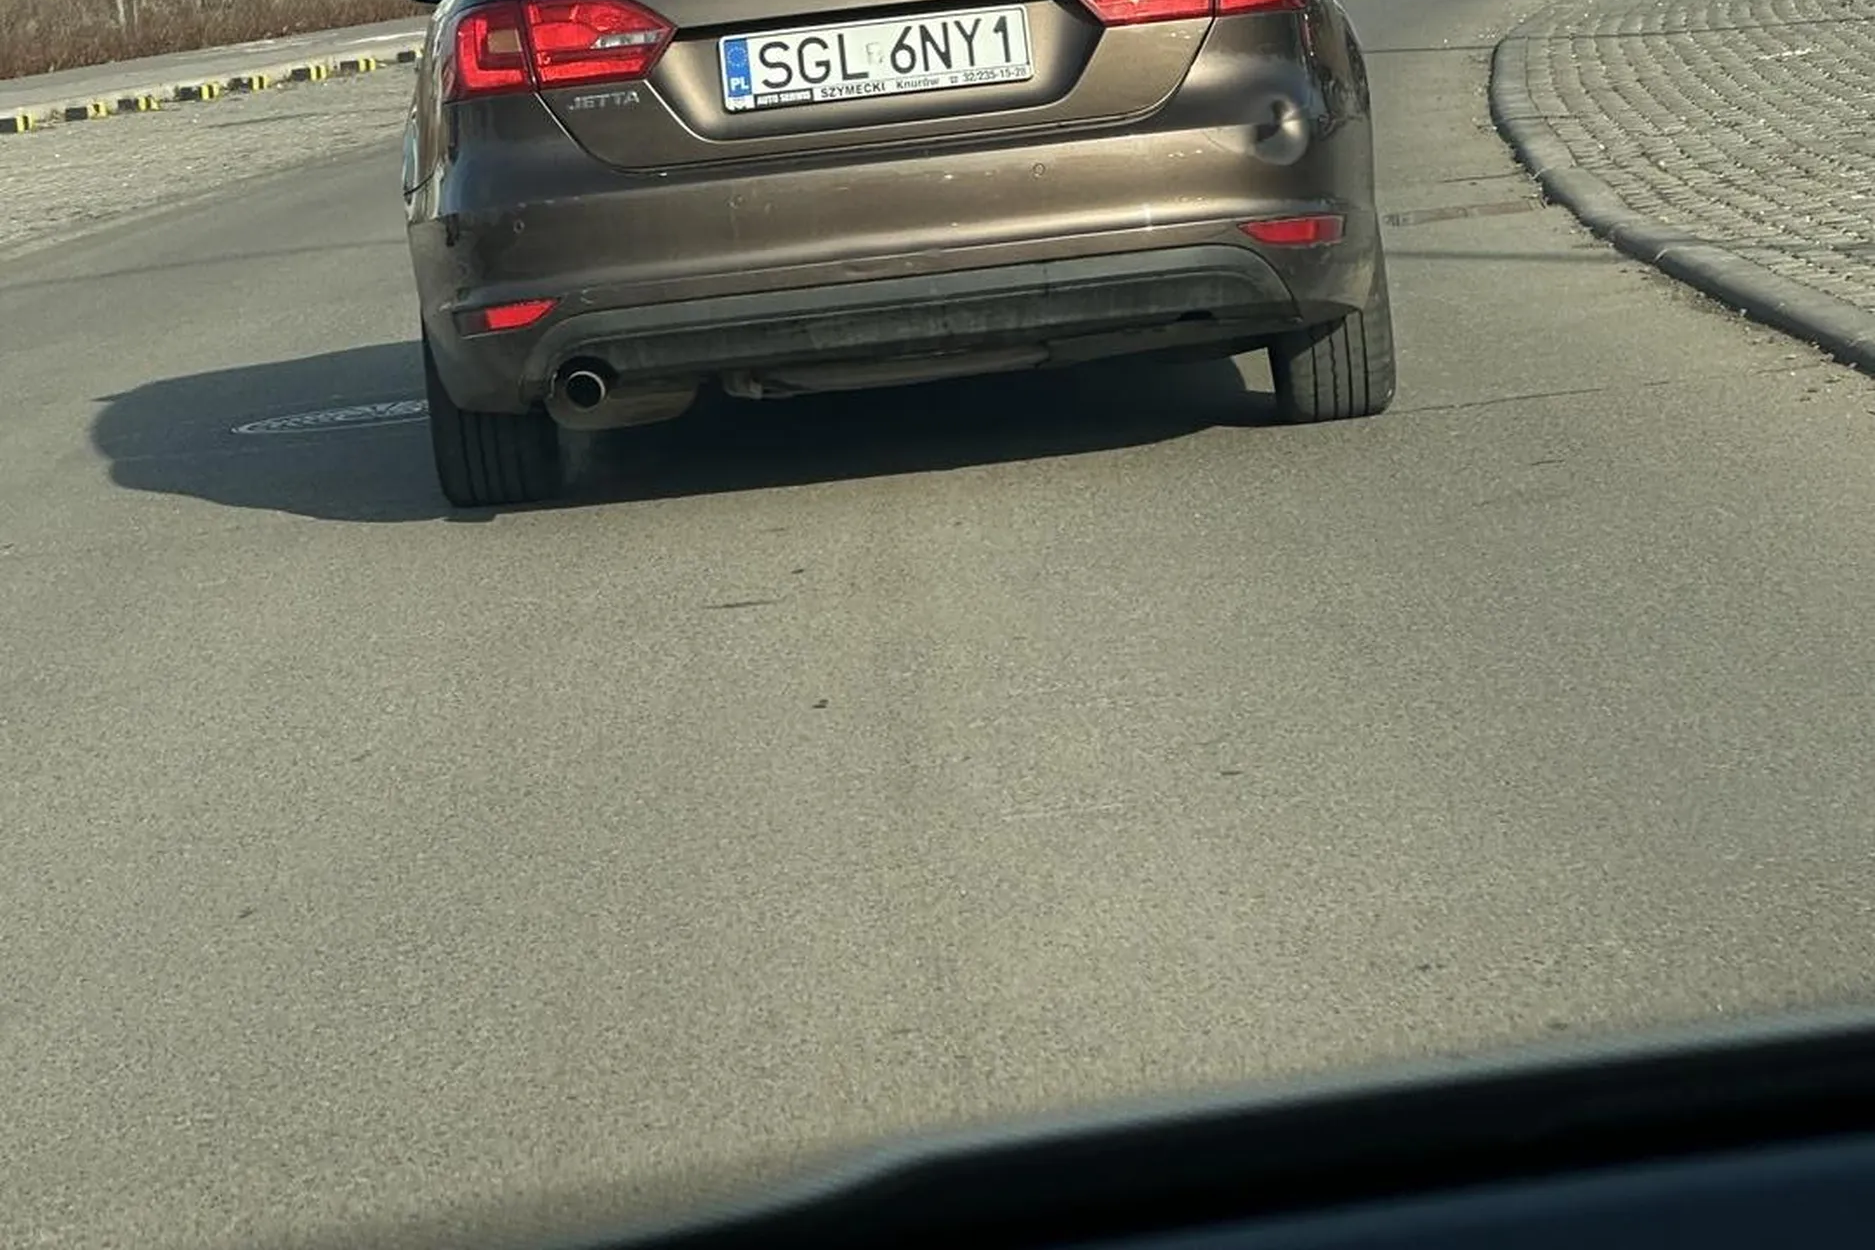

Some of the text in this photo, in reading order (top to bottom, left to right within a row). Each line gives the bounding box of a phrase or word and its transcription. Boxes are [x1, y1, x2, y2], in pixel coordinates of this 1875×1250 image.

[758, 15, 1012, 89] SGL 6NY1
[730, 76, 749, 91] PL
[820, 82, 886, 99] SZYMECKI
[568, 91, 640, 110] JETTA
